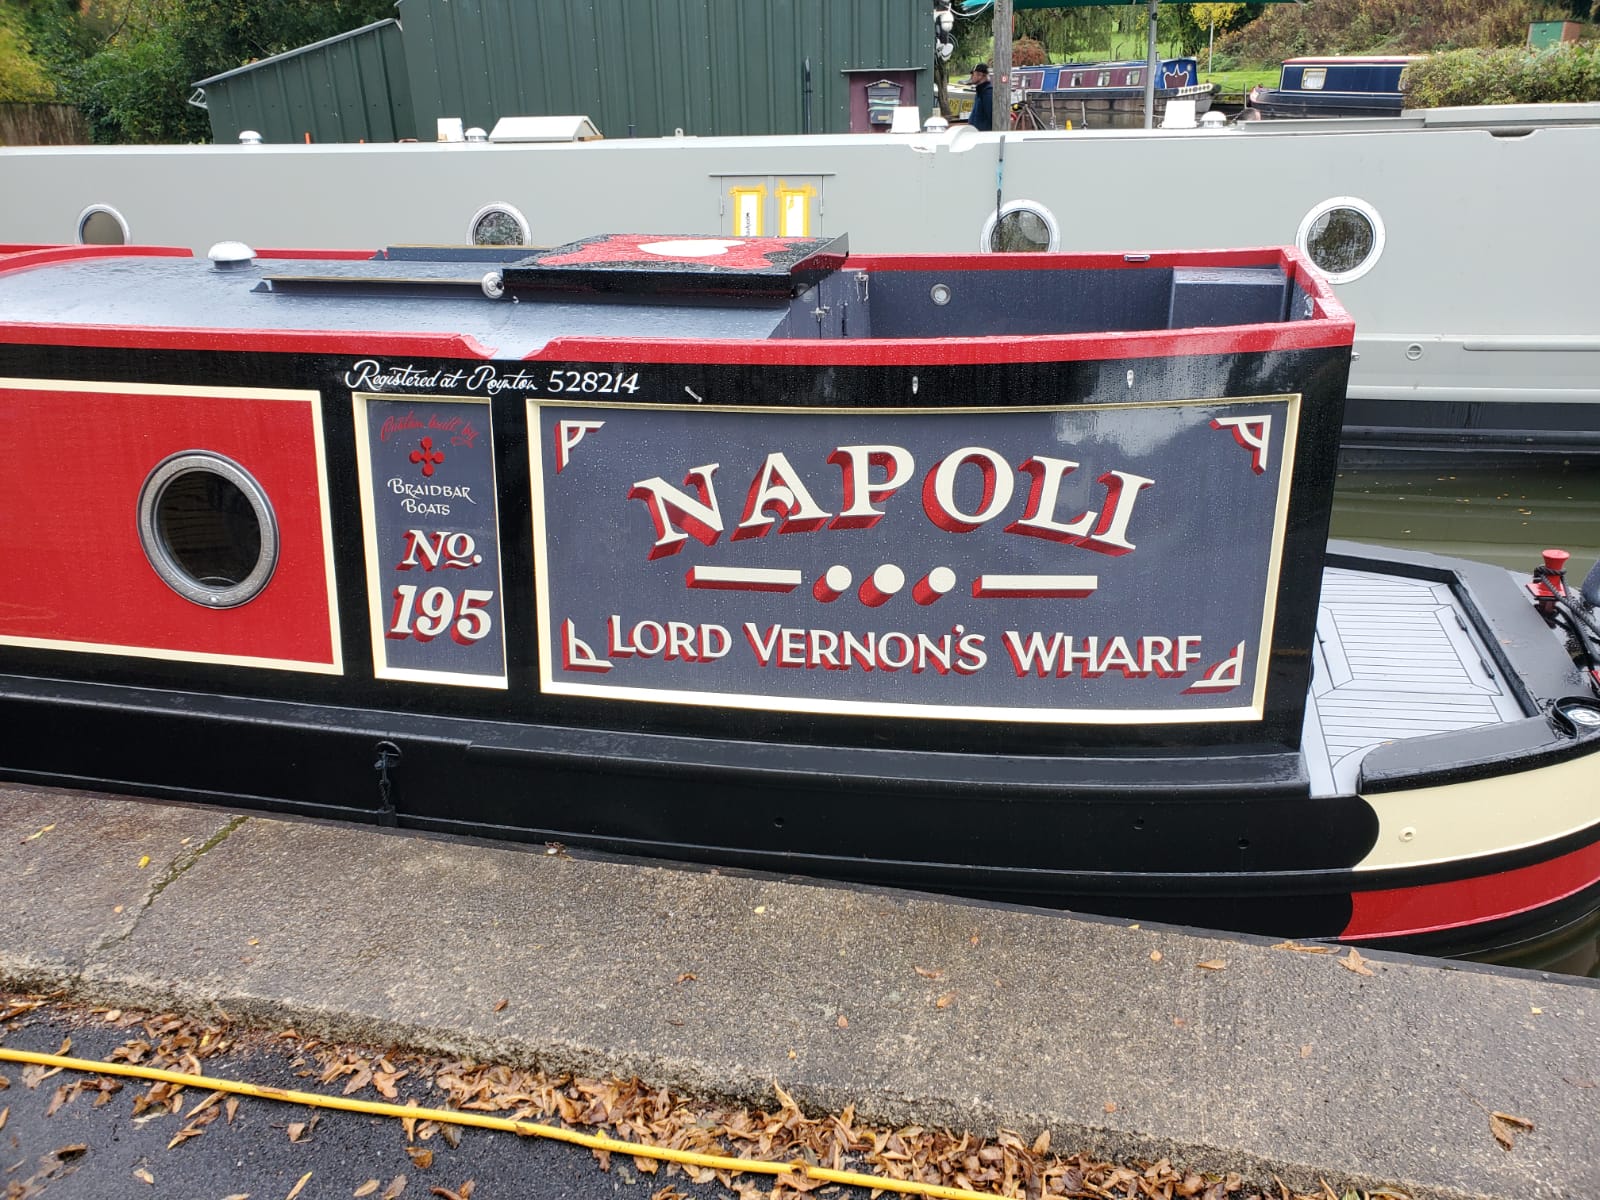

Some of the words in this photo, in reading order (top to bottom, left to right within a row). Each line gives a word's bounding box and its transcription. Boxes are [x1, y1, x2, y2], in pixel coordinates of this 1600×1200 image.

[345, 359, 441, 391] Registered
[440, 368, 468, 389] at
[466, 365, 538, 395] Poynton
[547, 370, 641, 394] 528214
[627, 445, 1155, 561] NAPOLI
[386, 584, 494, 646] 195
[608, 614, 732, 663] LORD
[742, 623, 988, 676] VERNON'S
[1001, 630, 1202, 679] WHARF
